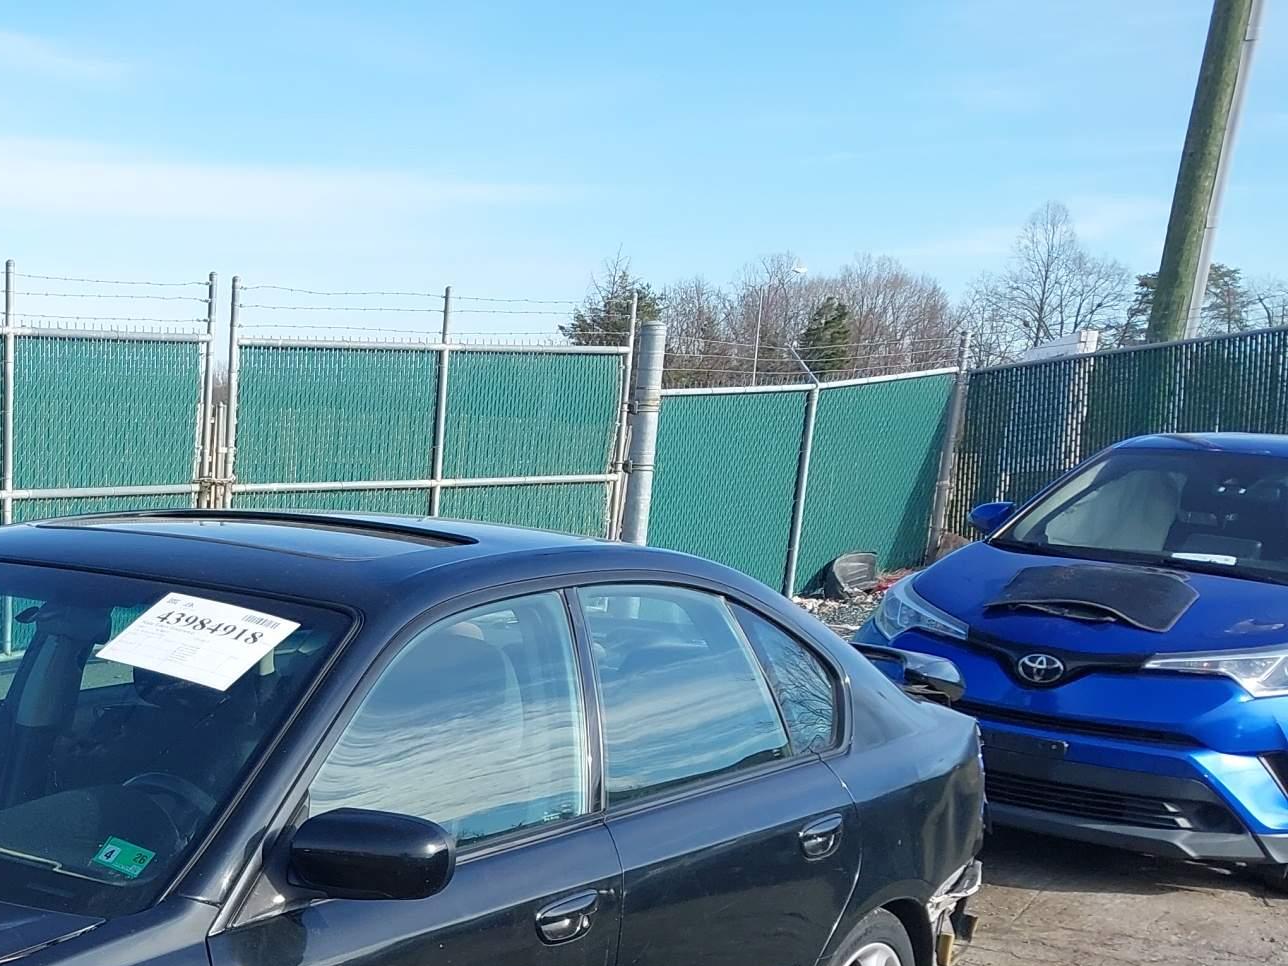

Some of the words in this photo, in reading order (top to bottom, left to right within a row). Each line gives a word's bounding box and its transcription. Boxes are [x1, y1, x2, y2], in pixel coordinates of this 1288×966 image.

[156, 610, 264, 645] 43984918
[104, 849, 116, 860] 4
[133, 853, 148, 864] 26
